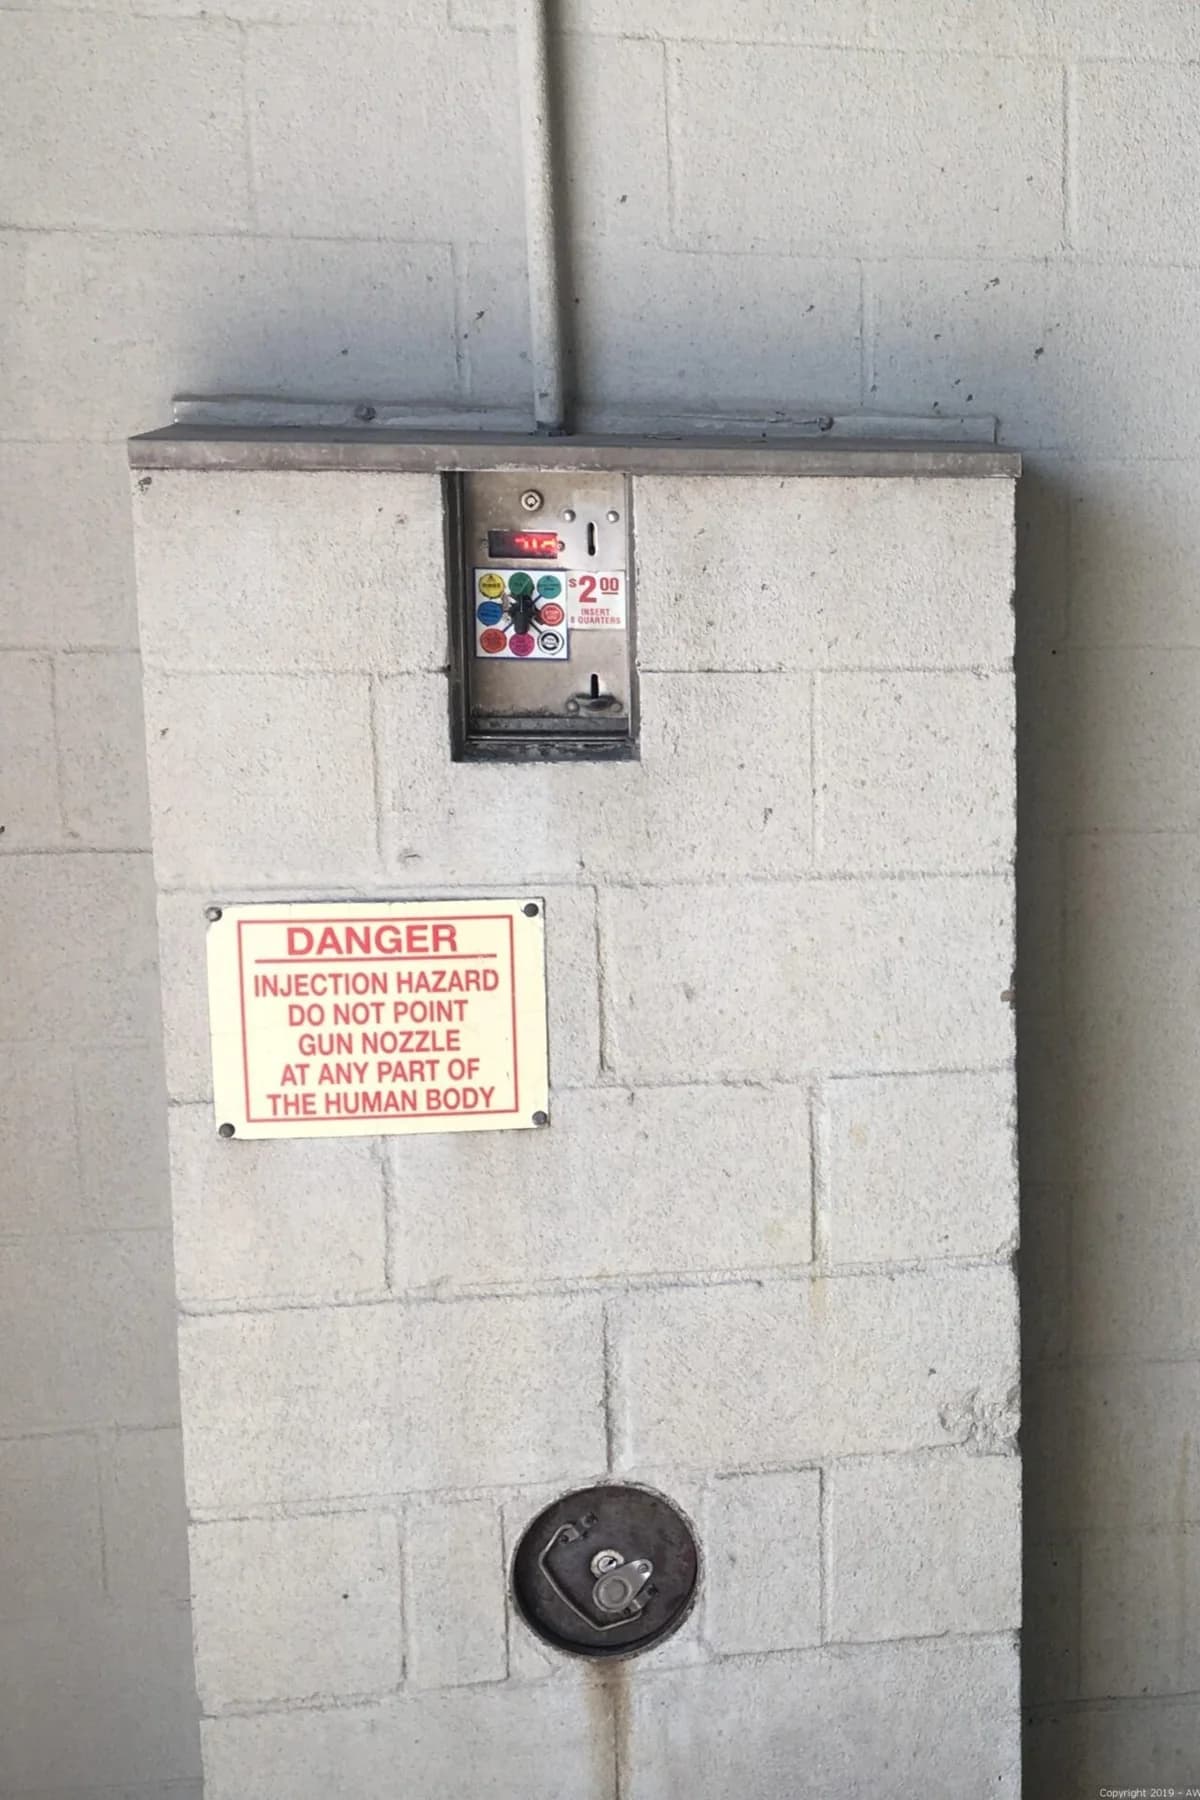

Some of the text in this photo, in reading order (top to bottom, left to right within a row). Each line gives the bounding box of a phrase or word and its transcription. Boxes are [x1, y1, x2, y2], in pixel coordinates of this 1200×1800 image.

[287, 923, 457, 956] DANGER
[254, 968, 499, 997] INJECTION HAZARD
[289, 999, 466, 1027] DO NOT POINT
[298, 1029, 460, 1056] GUN NOZZLE
[280, 1057, 480, 1086] AT ANY PART OF
[266, 1086, 495, 1116] THE HUMAN BODY
